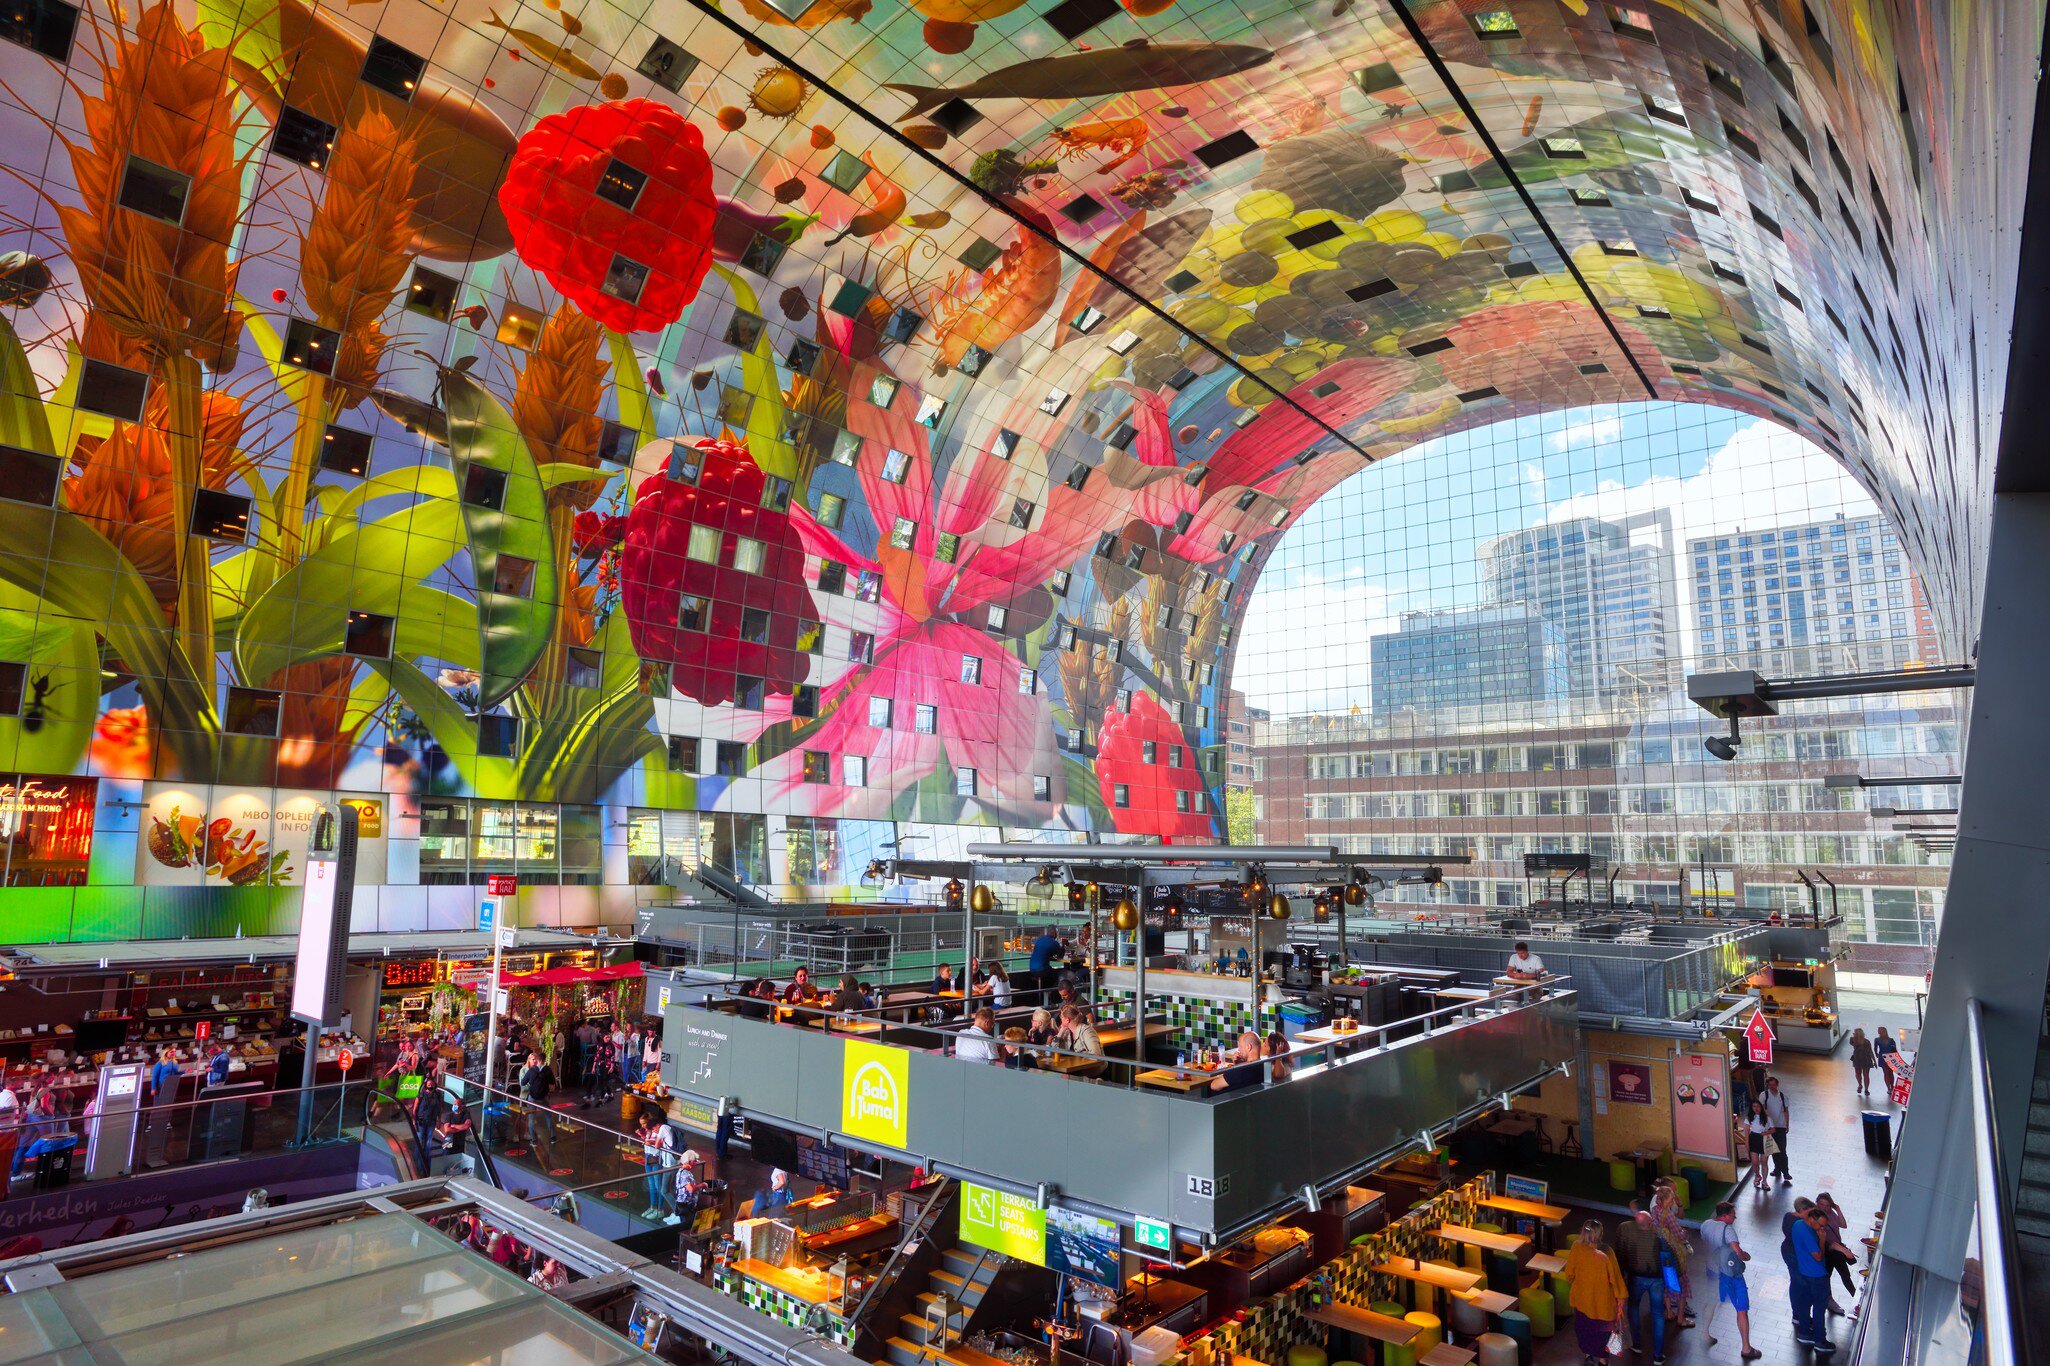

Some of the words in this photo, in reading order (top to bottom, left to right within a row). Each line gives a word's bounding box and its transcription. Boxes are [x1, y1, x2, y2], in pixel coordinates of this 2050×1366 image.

[18, 781, 69, 801] Food
[37, 804, 62, 813] HONG
[448, 951, 488, 960] Interparking
[158, 975, 220, 992] FAMILY
[224, 973, 265, 989] NUTS
[1692, 1020, 1708, 1030] 14
[400, 1083, 420, 1091] casa
[862, 1075, 889, 1101] Bab
[857, 1095, 893, 1120] Tuma
[1189, 1177, 1213, 1197] 18
[1215, 1177, 1229, 1196] 18
[107, 1201, 132, 1212] Jules
[134, 1193, 168, 1207] Deelder
[1000, 1191, 1037, 1212] TERRACE
[1000, 1205, 1025, 1223] SEATS
[1000, 1219, 1039, 1242] UPSTAIRS
